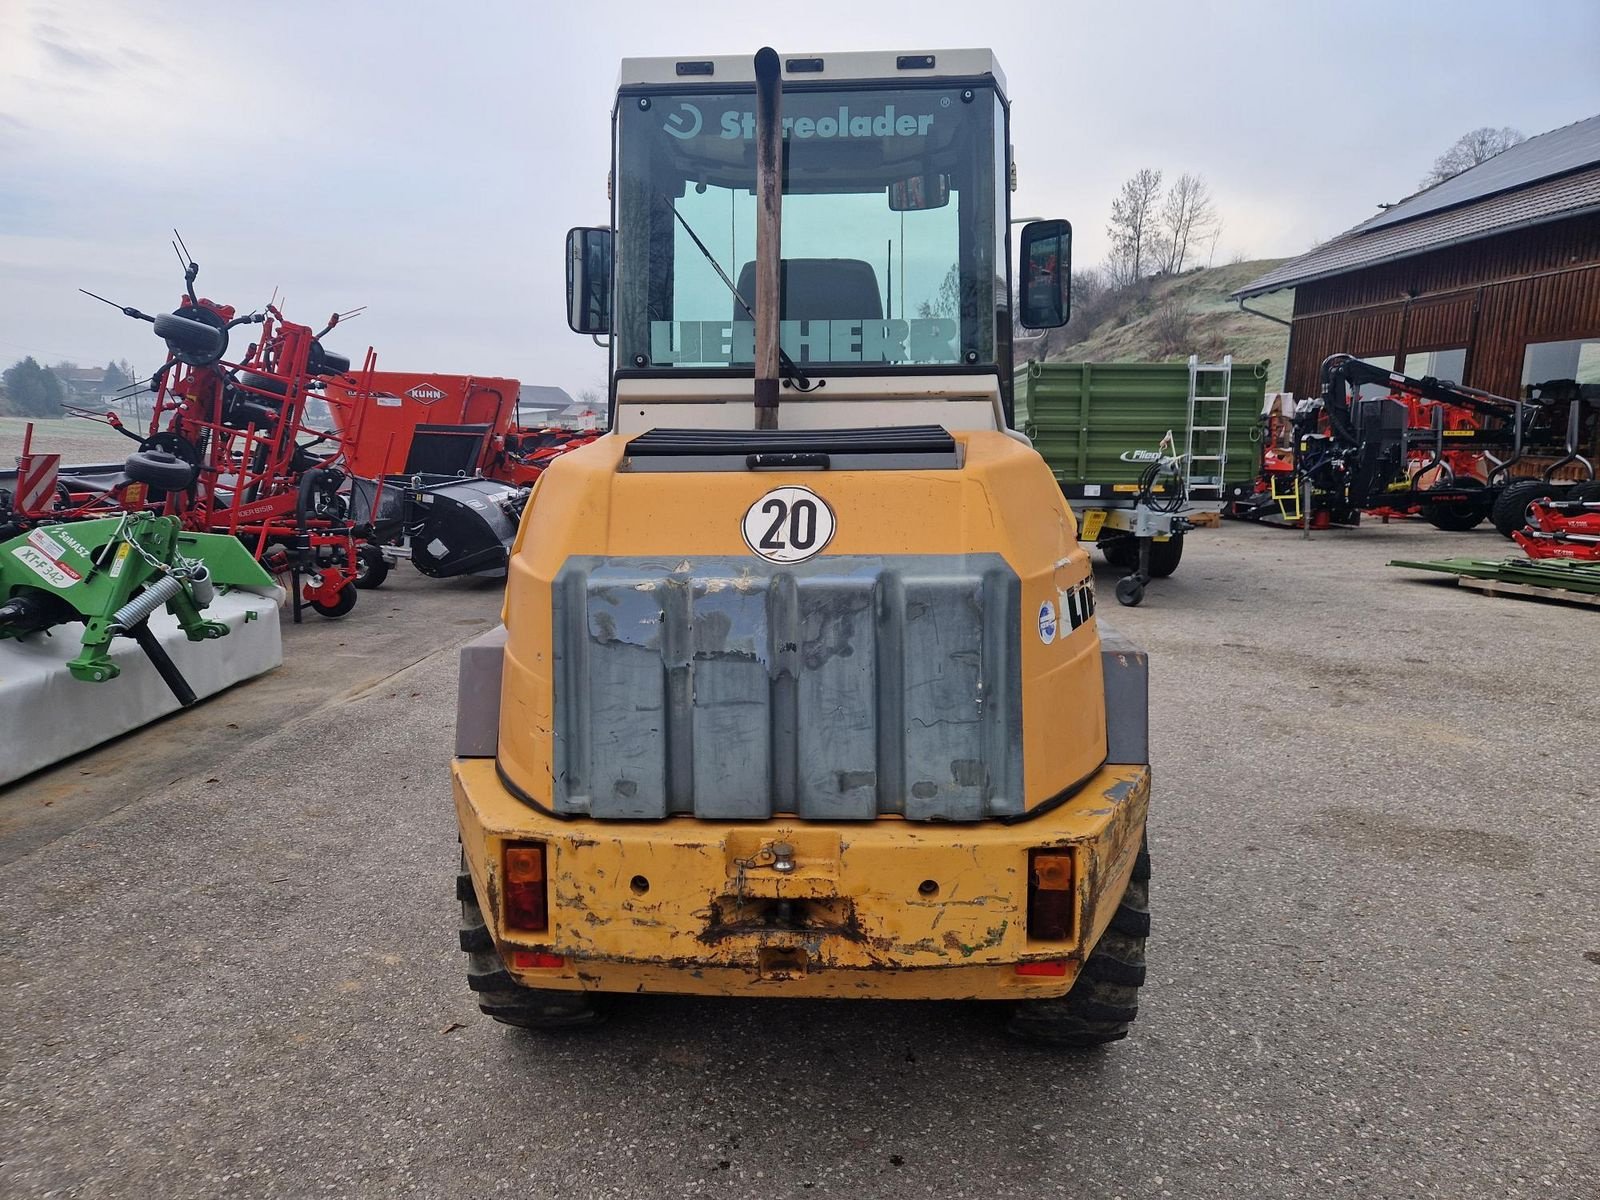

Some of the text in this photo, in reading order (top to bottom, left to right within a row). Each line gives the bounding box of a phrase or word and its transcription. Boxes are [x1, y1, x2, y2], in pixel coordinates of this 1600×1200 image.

[720, 105, 934, 140] Streolader
[411, 390, 441, 399] KUHN
[759, 498, 817, 550] 20
[58, 530, 91, 558] SaMASZ
[22, 549, 47, 568] XT-F
[44, 563, 65, 584] 342
